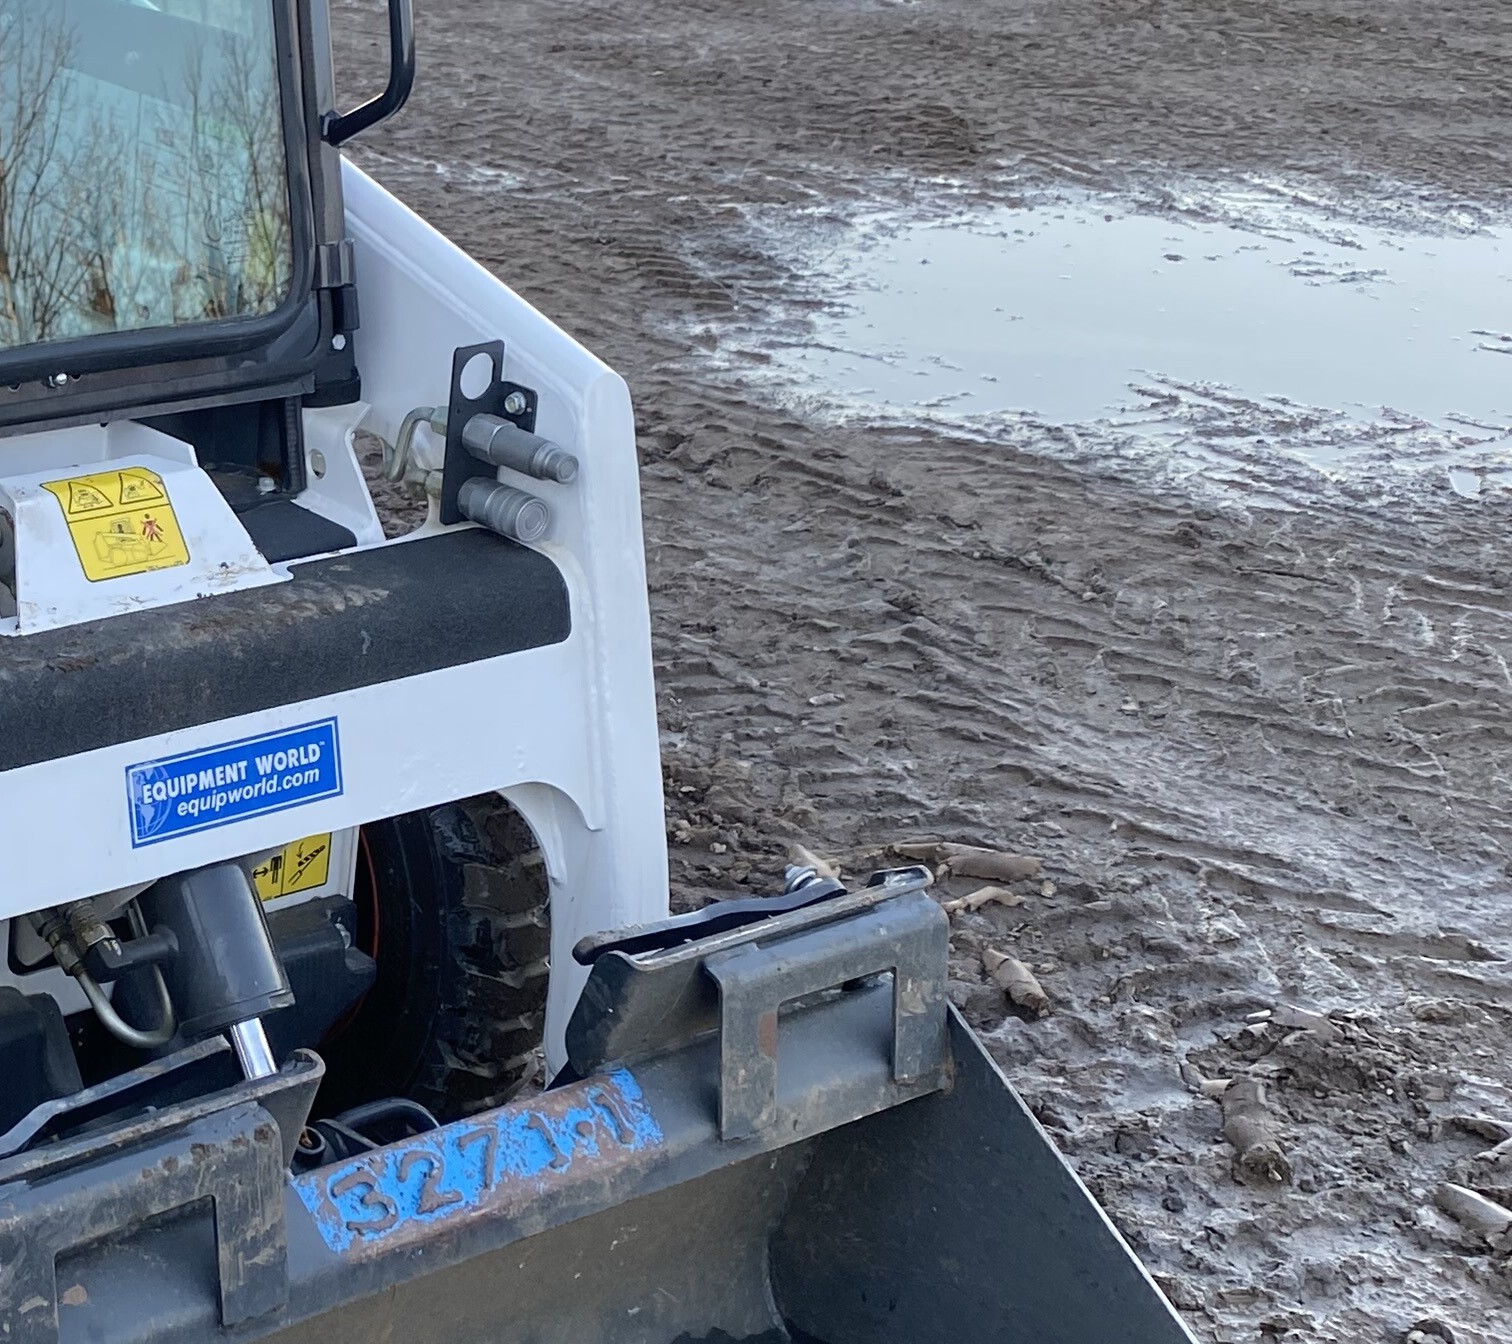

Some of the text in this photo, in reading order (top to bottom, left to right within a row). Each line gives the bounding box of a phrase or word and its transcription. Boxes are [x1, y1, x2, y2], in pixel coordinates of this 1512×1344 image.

[142, 743, 321, 805] EQUIPMENT WORLD
[177, 767, 320, 817] equipworld.com
